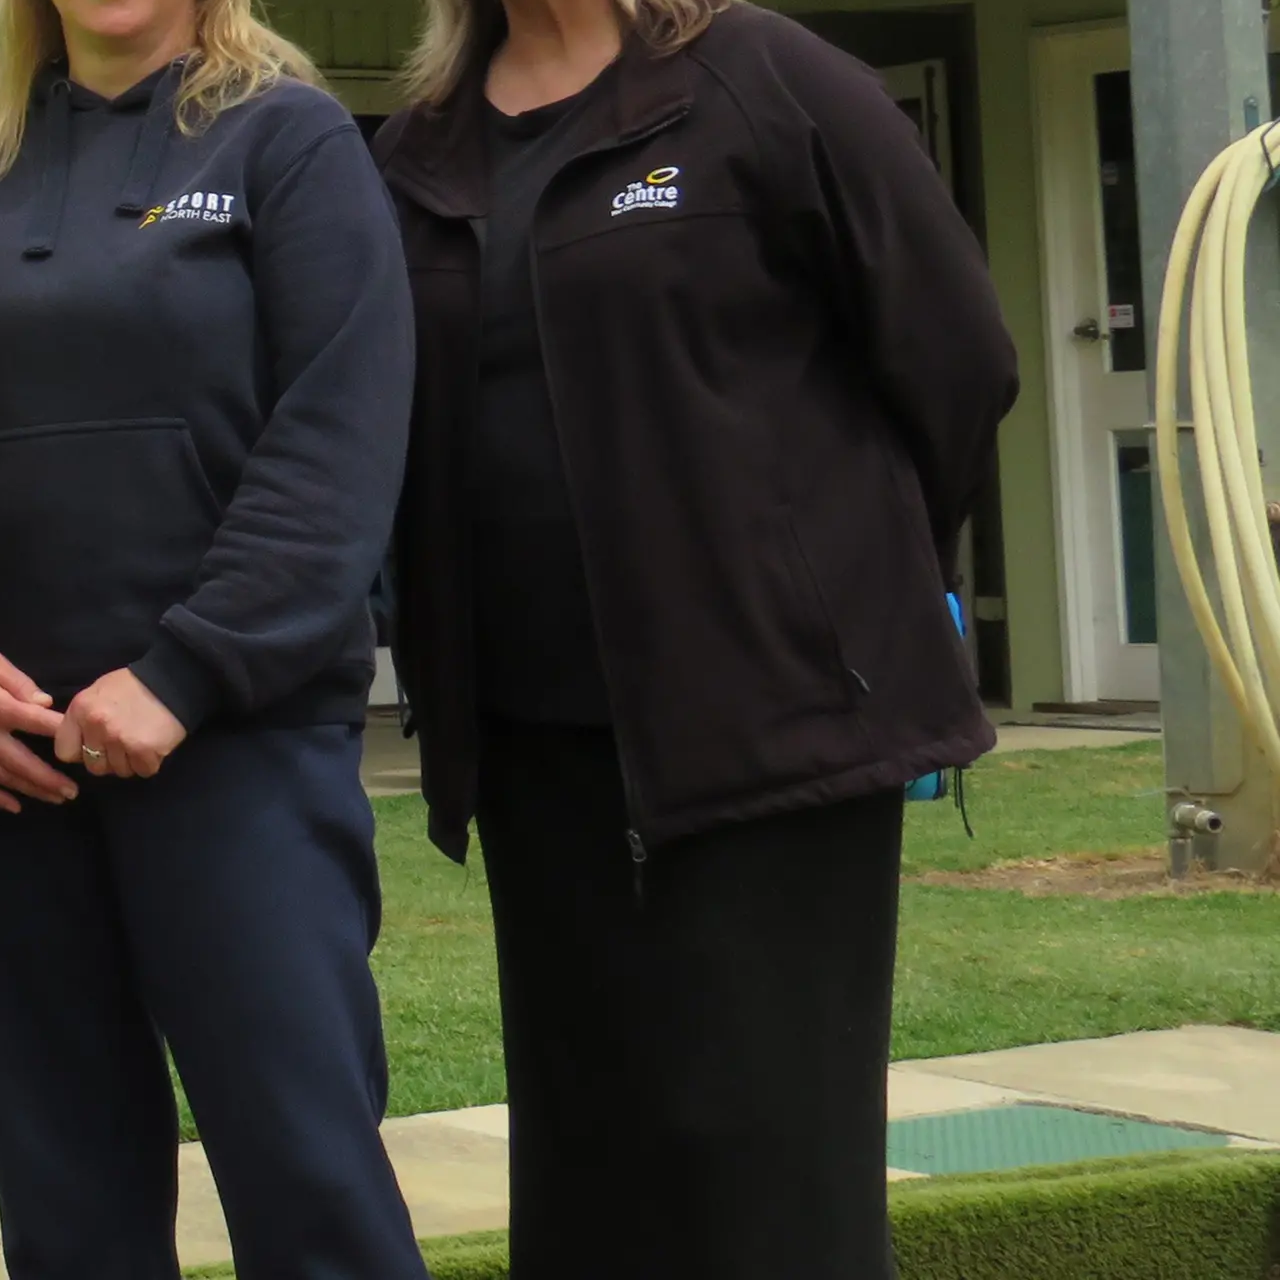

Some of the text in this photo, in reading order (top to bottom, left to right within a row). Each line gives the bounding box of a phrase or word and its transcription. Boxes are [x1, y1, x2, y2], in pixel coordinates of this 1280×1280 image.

[165, 191, 235, 213] SPORT
[612, 185, 678, 209] Centre
[160, 209, 232, 223] NORTH EAST
